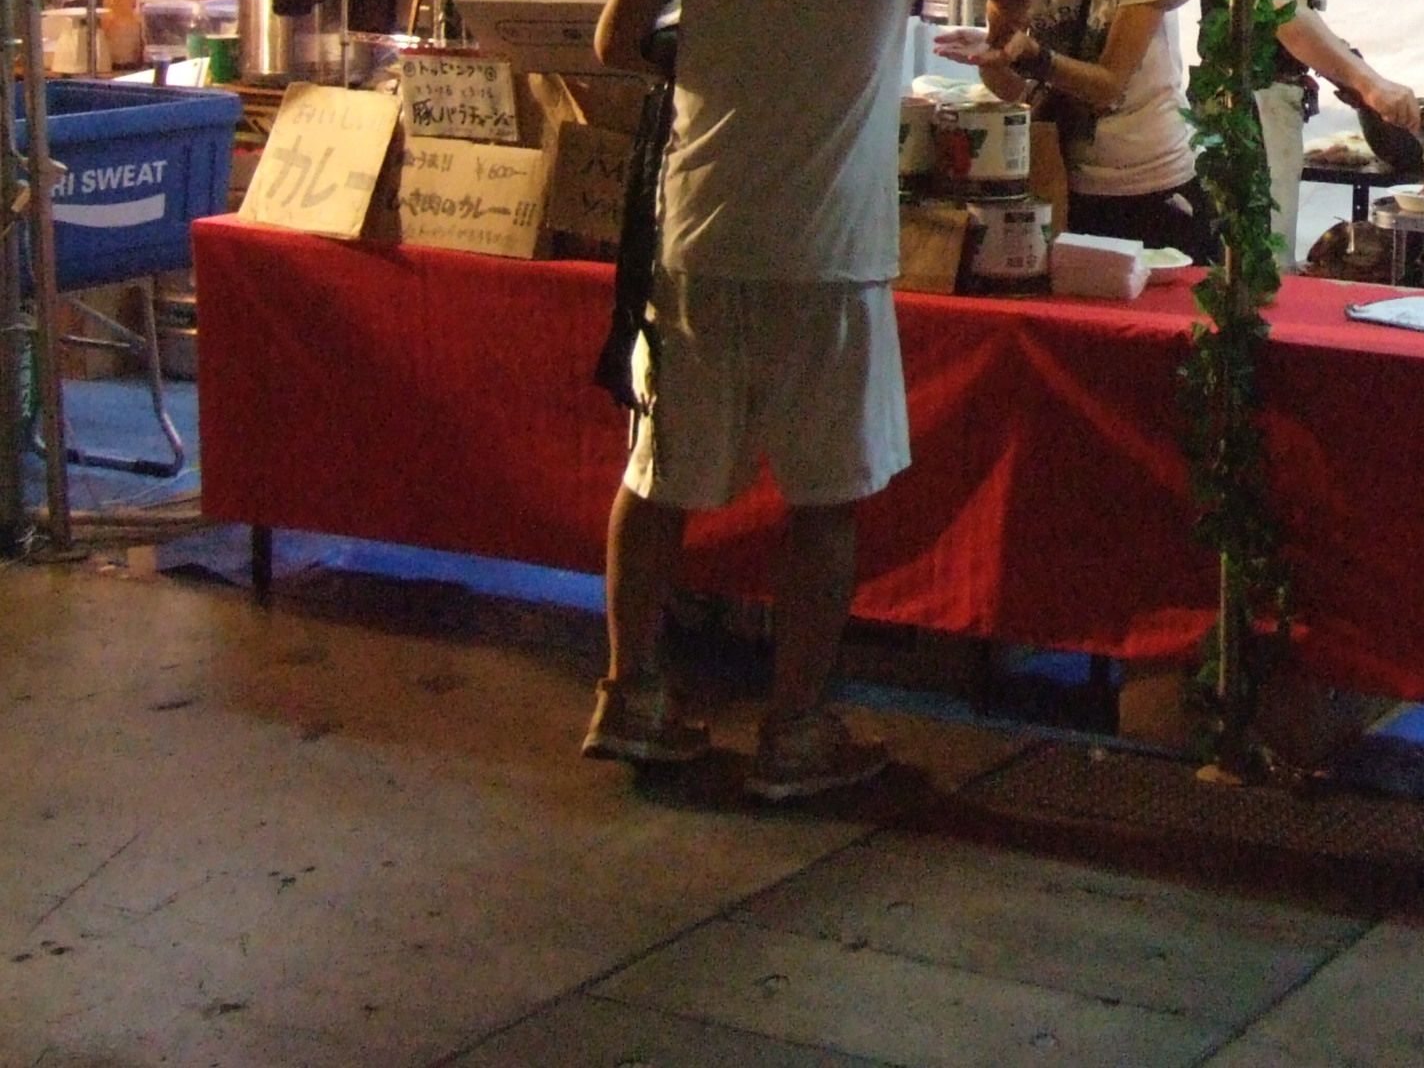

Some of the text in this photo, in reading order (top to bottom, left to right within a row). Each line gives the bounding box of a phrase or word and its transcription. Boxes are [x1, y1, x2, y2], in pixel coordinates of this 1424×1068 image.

[80, 159, 169, 195] SWEAT
[265, 134, 378, 210] カレー
